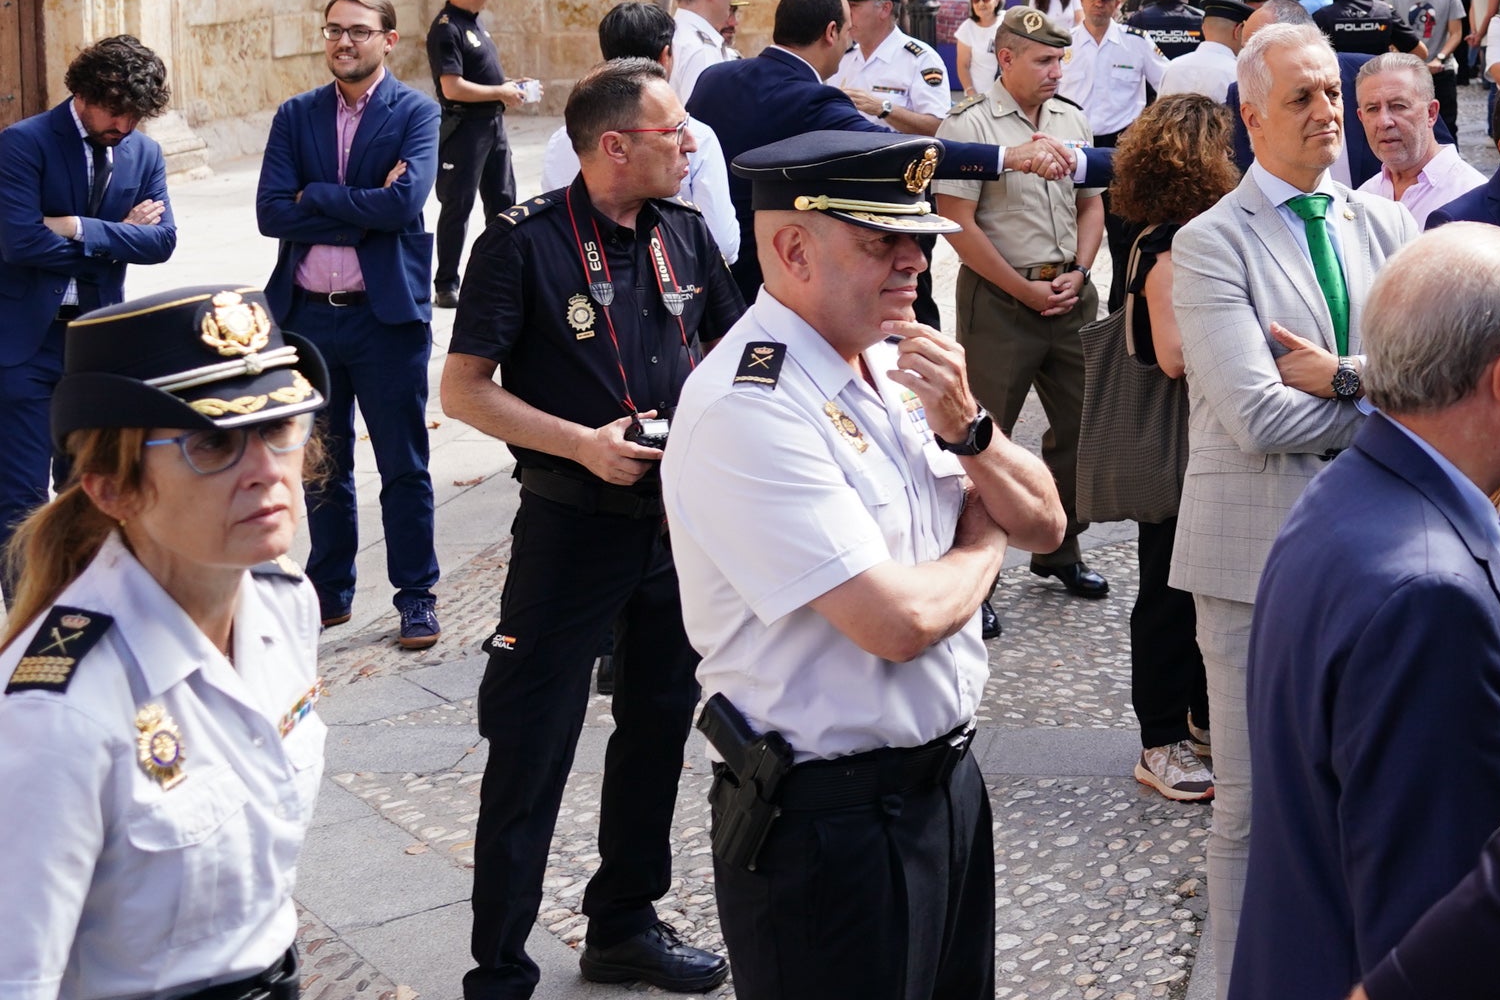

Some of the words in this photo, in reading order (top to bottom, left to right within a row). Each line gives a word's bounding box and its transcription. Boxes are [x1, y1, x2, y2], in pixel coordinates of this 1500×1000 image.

[1335, 22, 1380, 32] POLICIA
[584, 241, 602, 272] EOS
[651, 237, 671, 283] Canon
